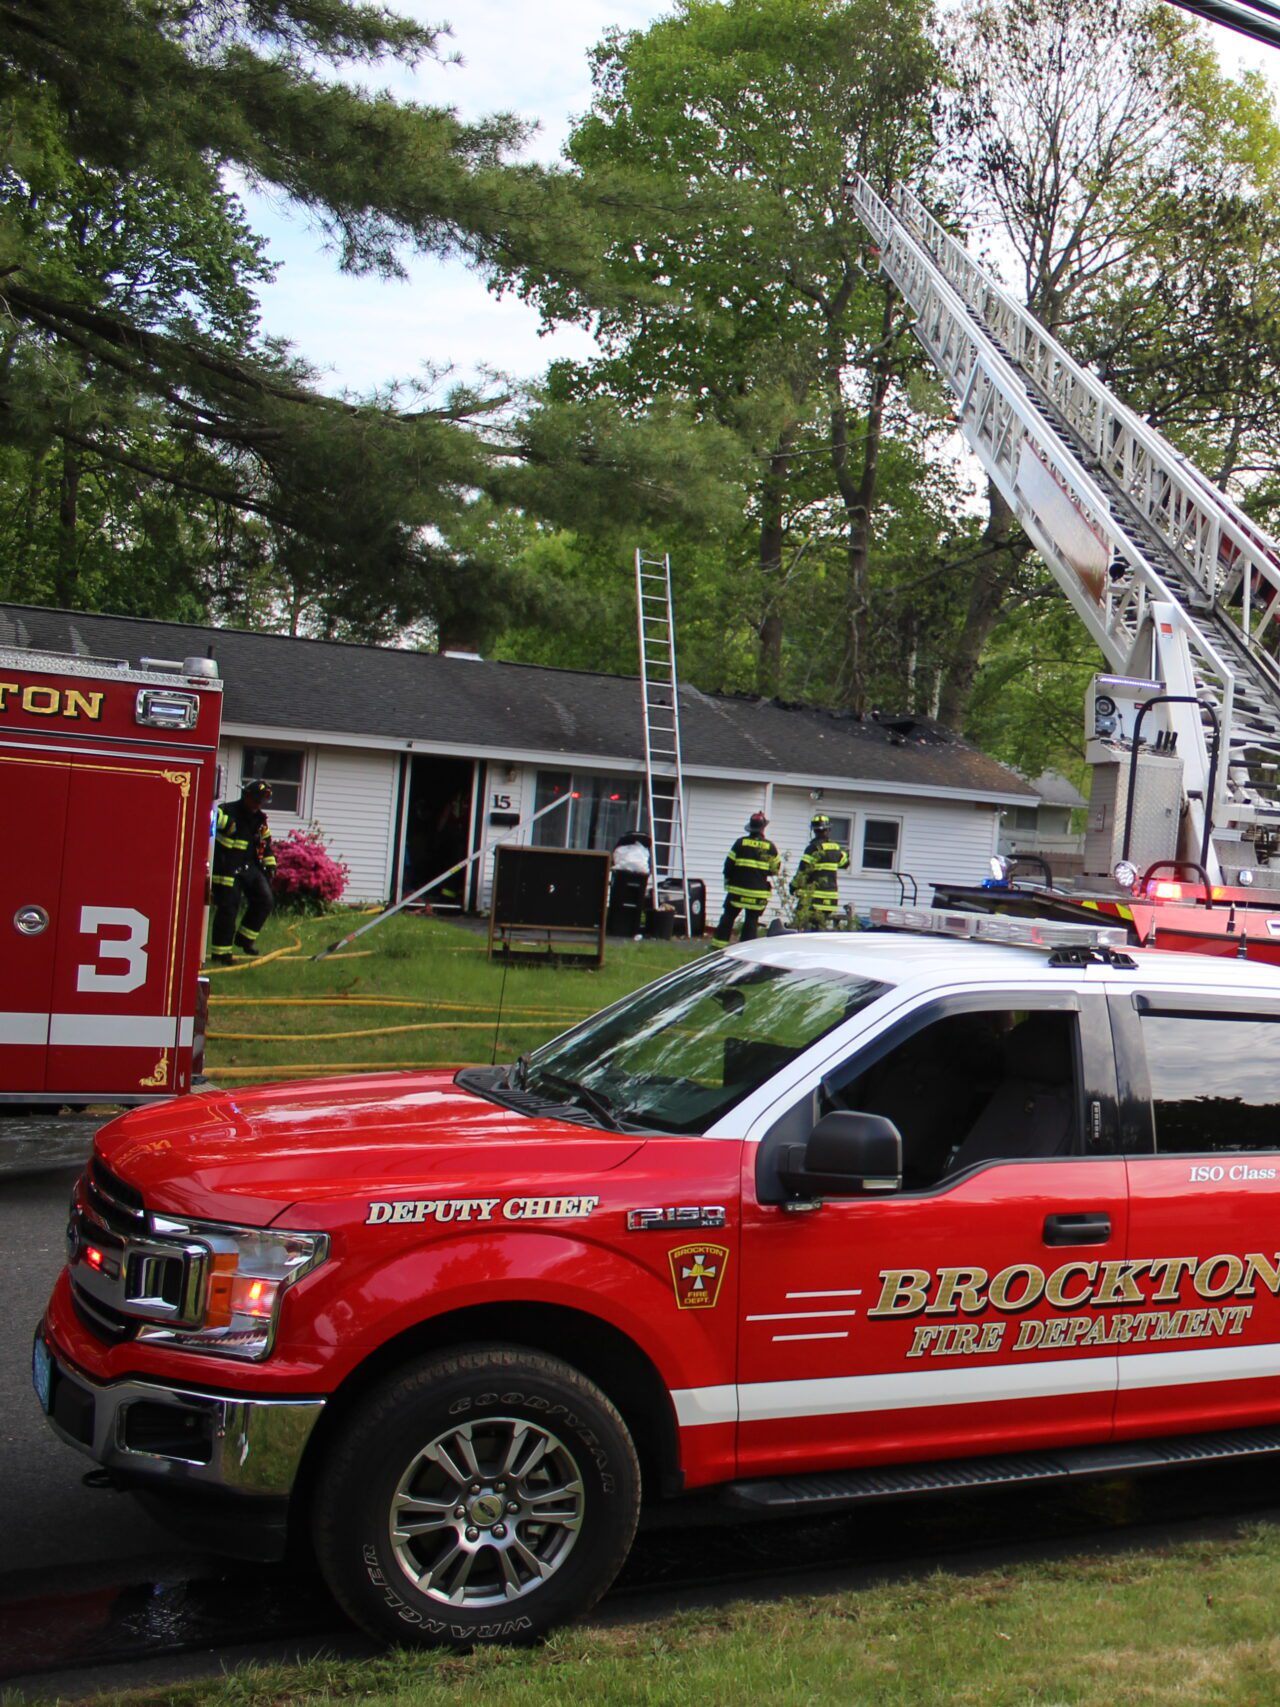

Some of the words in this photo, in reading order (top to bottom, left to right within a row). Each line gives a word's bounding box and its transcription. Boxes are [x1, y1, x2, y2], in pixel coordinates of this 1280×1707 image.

[494, 794, 511, 810] 15
[77, 905, 150, 994] 3
[1188, 1165, 1225, 1182] ISO
[1229, 1164, 1276, 1181] Class
[366, 1198, 501, 1225] DEPUTY
[502, 1195, 600, 1221] CHIEF
[674, 1247, 723, 1258] BROCKTON
[687, 1290, 709, 1298] FIRE
[906, 1322, 1007, 1358] FIRE
[1012, 1306, 1253, 1351] DEPARTMENT
[449, 1392, 616, 1495] GOODYEAR
[362, 1543, 533, 1639] WRANGLER
